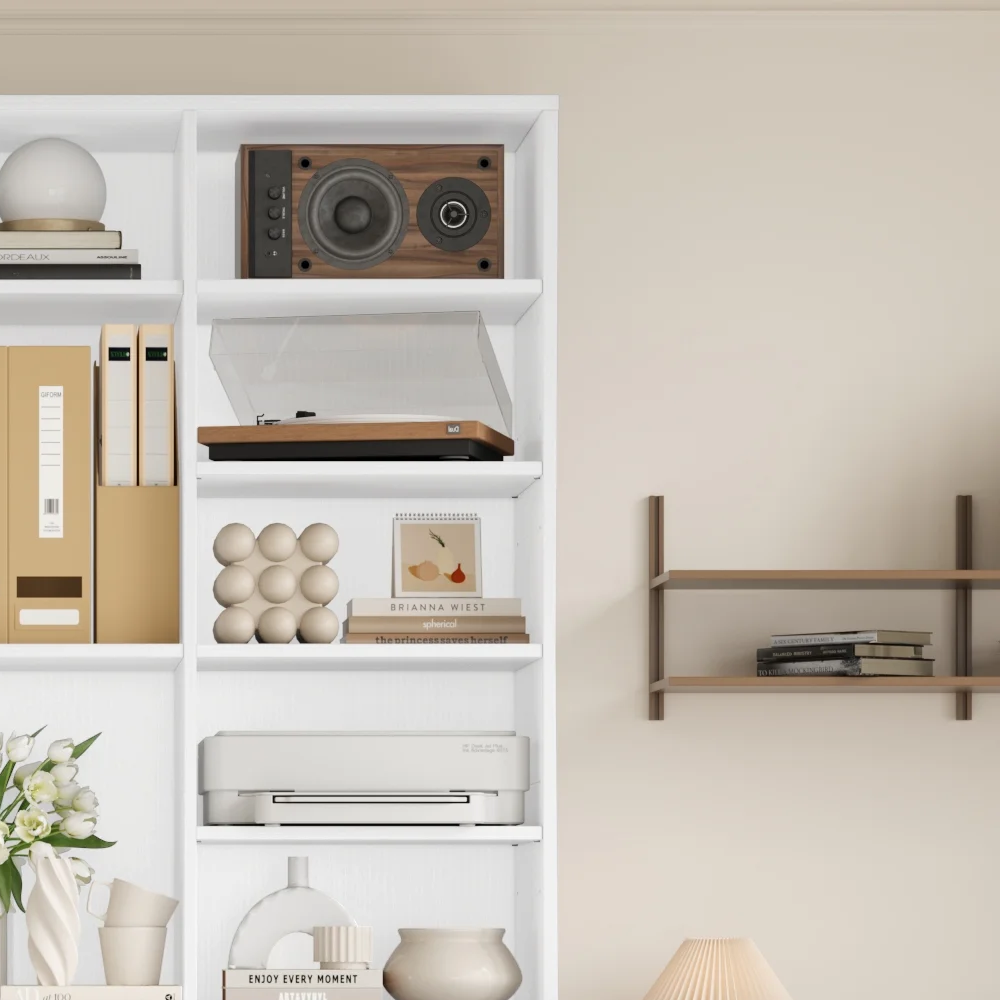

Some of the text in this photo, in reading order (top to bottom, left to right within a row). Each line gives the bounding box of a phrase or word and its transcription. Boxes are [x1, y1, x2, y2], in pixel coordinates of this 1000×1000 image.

[422, 619, 457, 631] spherical
[375, 636, 393, 644] the
[248, 974, 358, 984] ENJOY EVERY MOMENT
